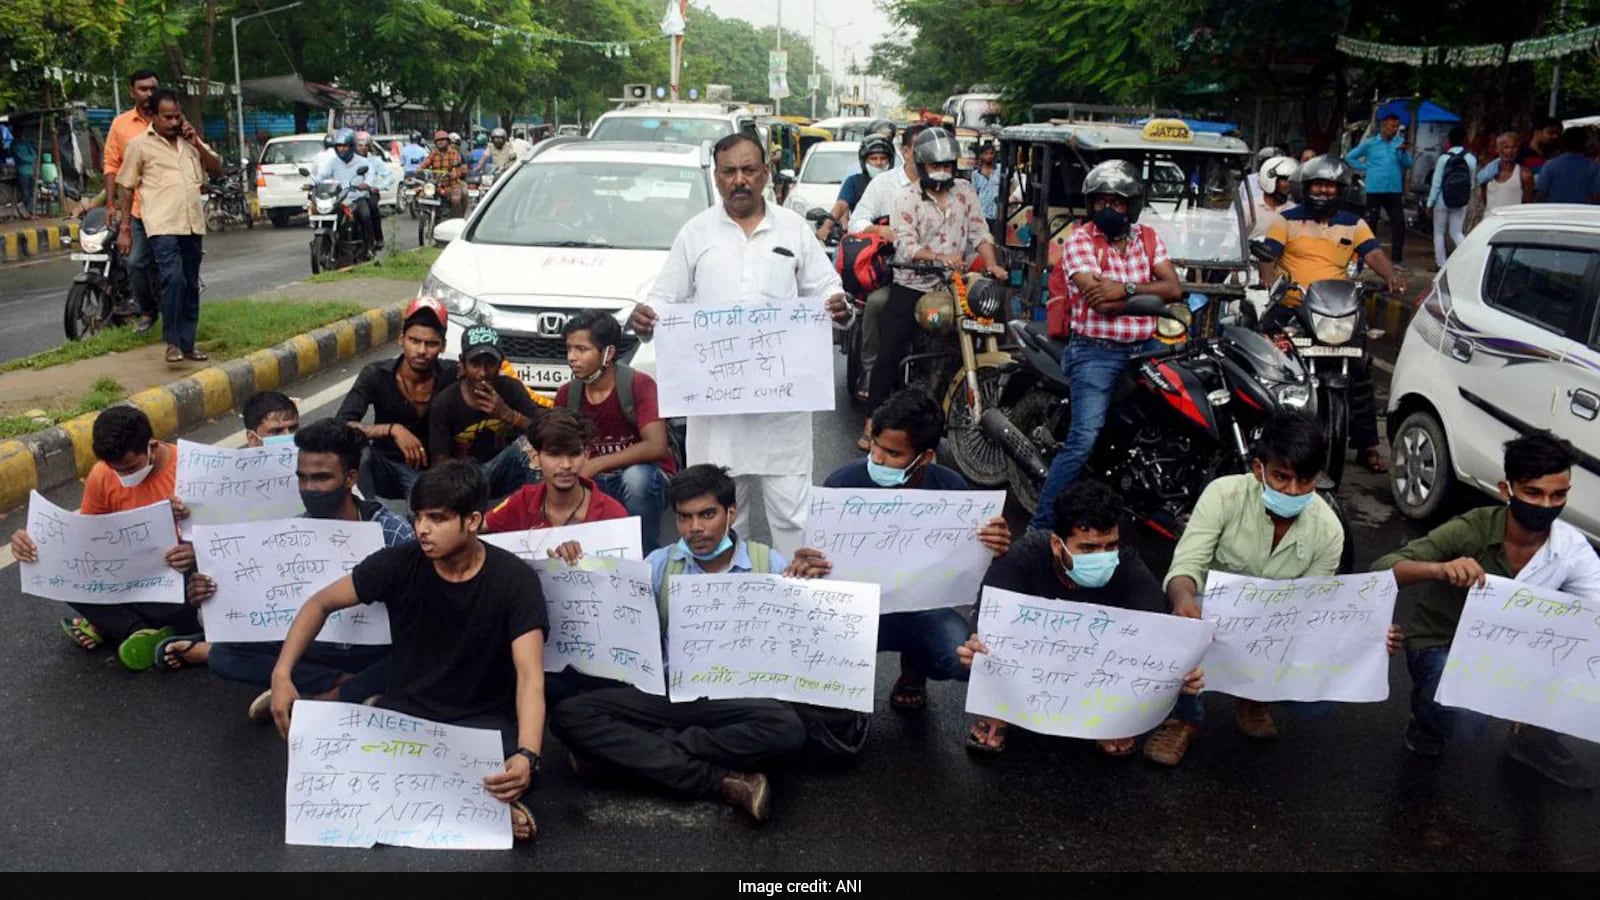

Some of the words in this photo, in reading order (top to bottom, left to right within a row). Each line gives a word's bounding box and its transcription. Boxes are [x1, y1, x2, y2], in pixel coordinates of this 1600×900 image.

[469, 334, 499, 345] BOY
[694, 337, 740, 363] आप
[754, 383, 794, 399] KUMAR
[810, 530, 875, 557] आप
[1212, 614, 1261, 632] आप
[1467, 619, 1528, 645] आप
[361, 740, 431, 757] न्याय
[374, 801, 444, 825] NTA
